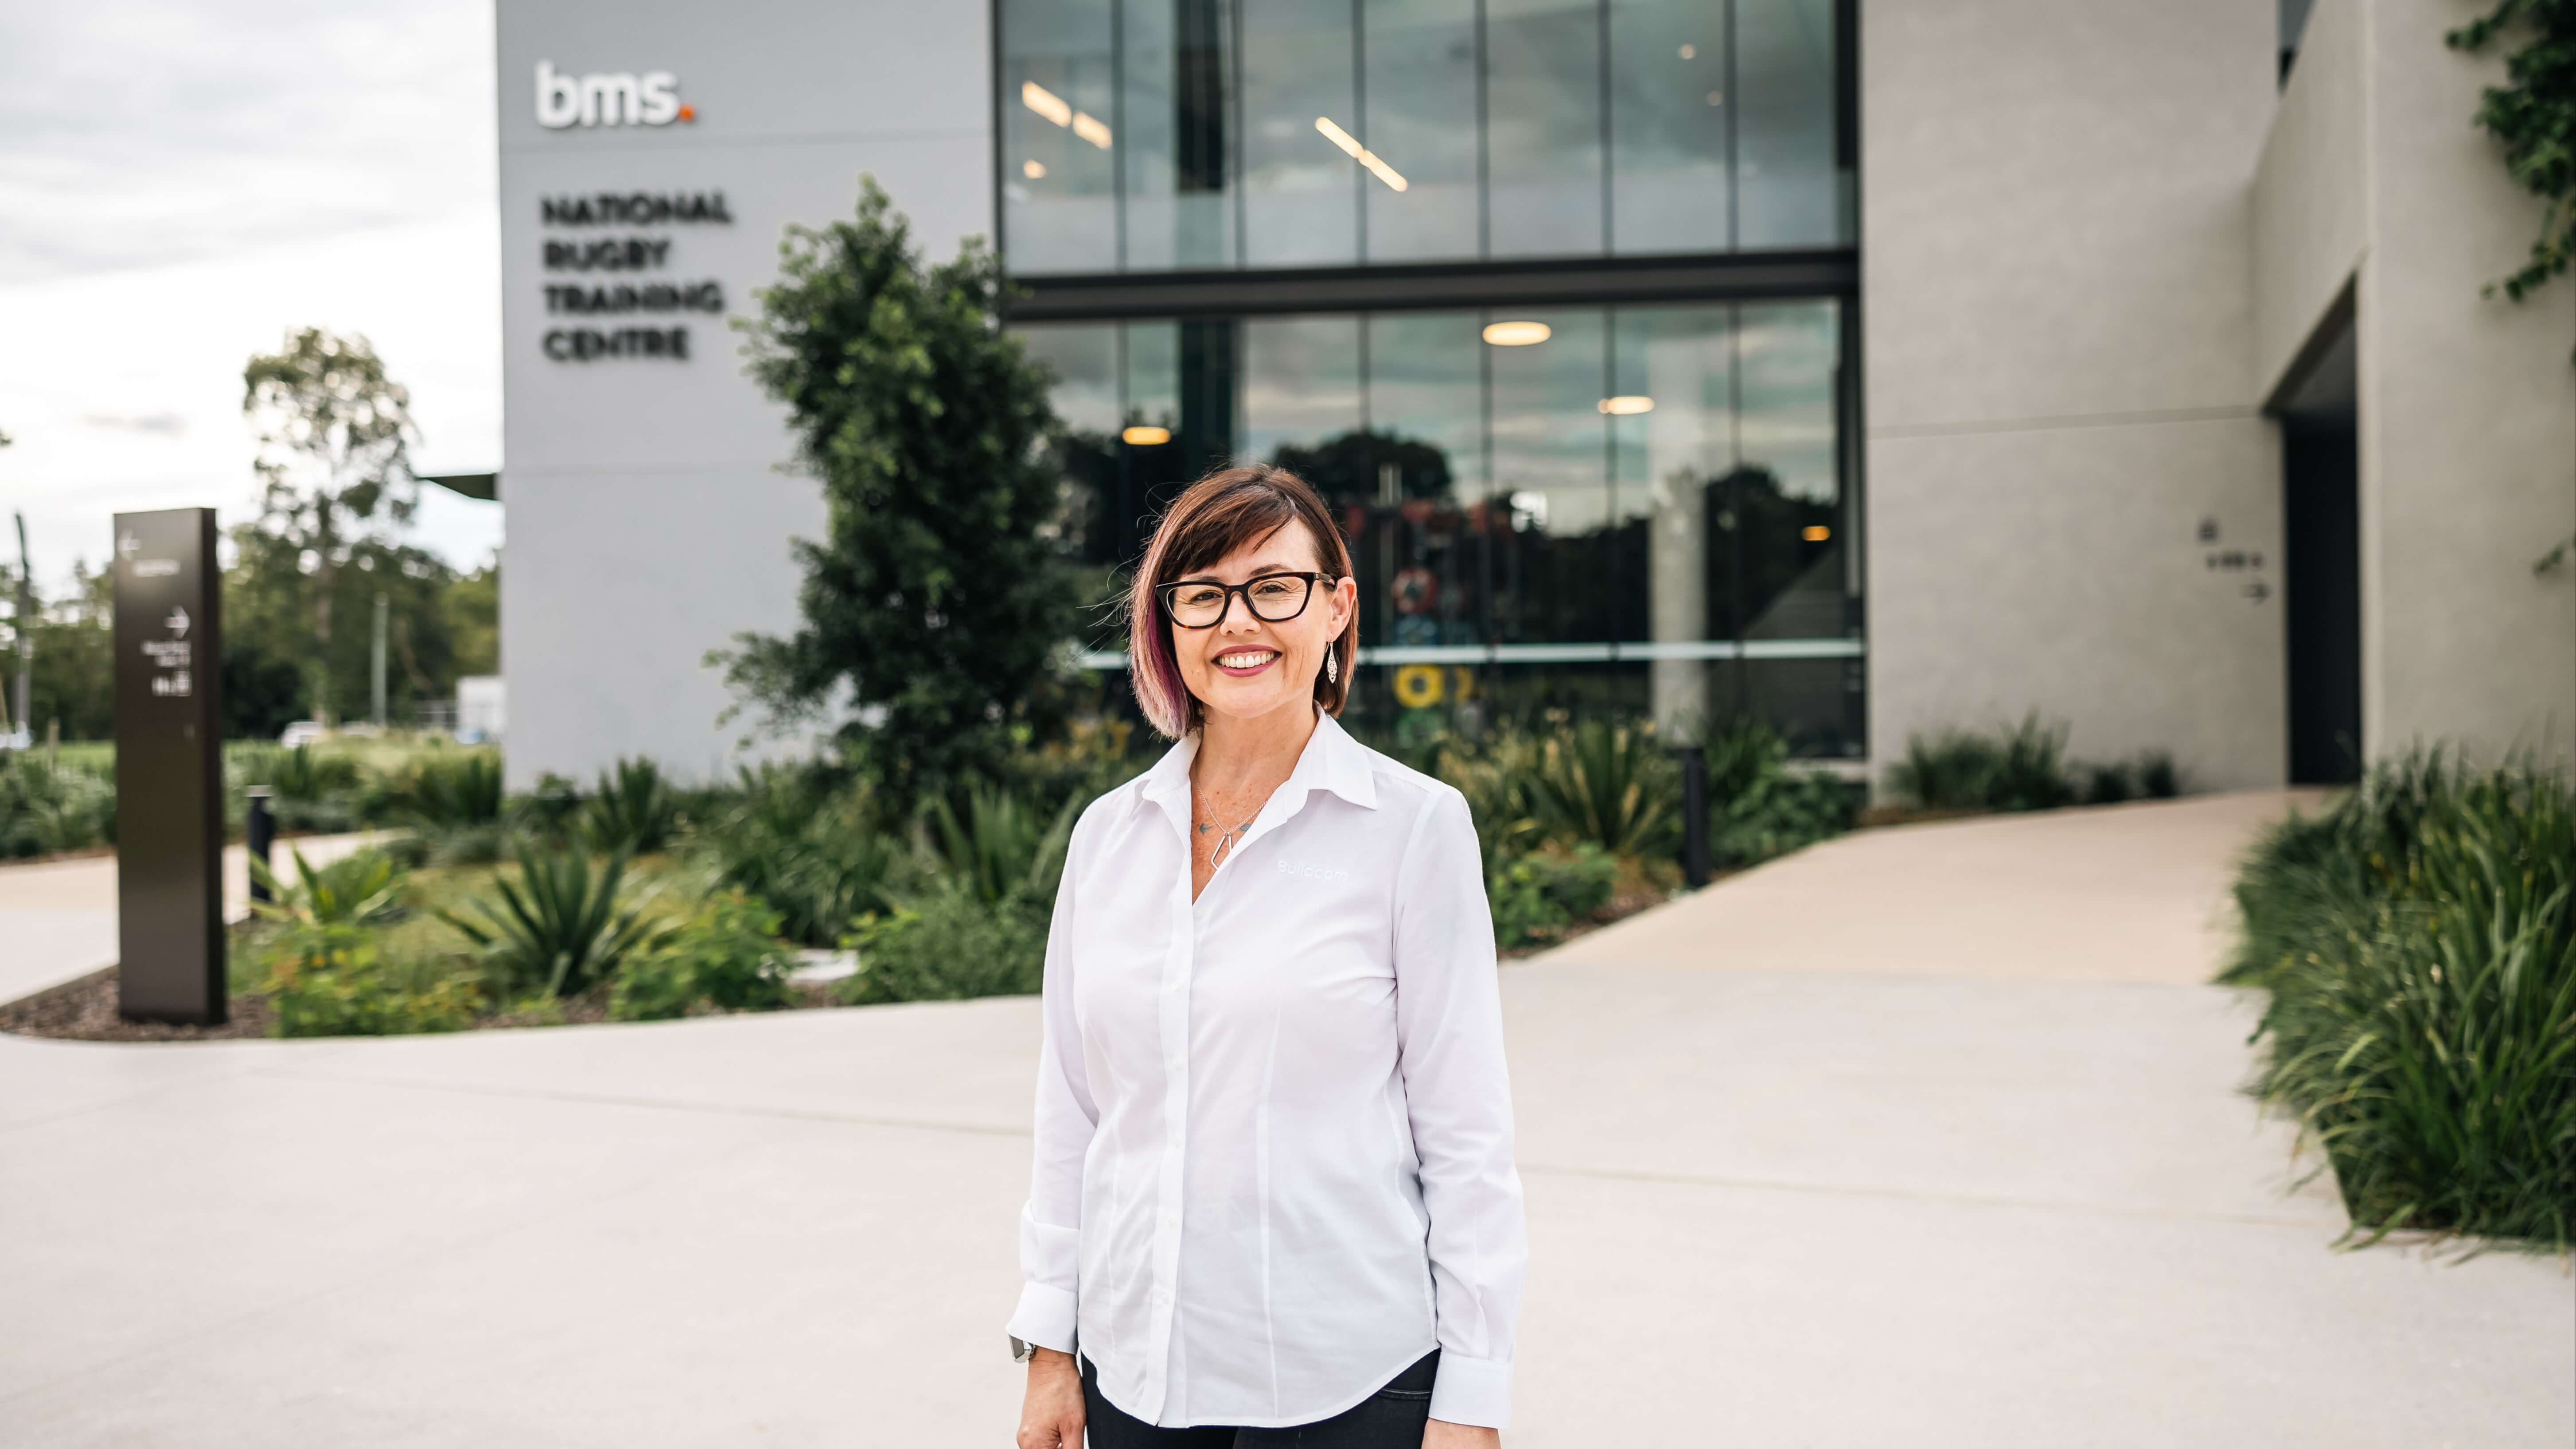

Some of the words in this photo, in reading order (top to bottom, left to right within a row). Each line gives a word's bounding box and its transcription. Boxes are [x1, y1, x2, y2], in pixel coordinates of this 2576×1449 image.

[541, 191, 733, 225] NATIONAL
[543, 238, 671, 270] RUGBY
[543, 281, 725, 314] TRAINING
[542, 327, 690, 361] CENTRE
